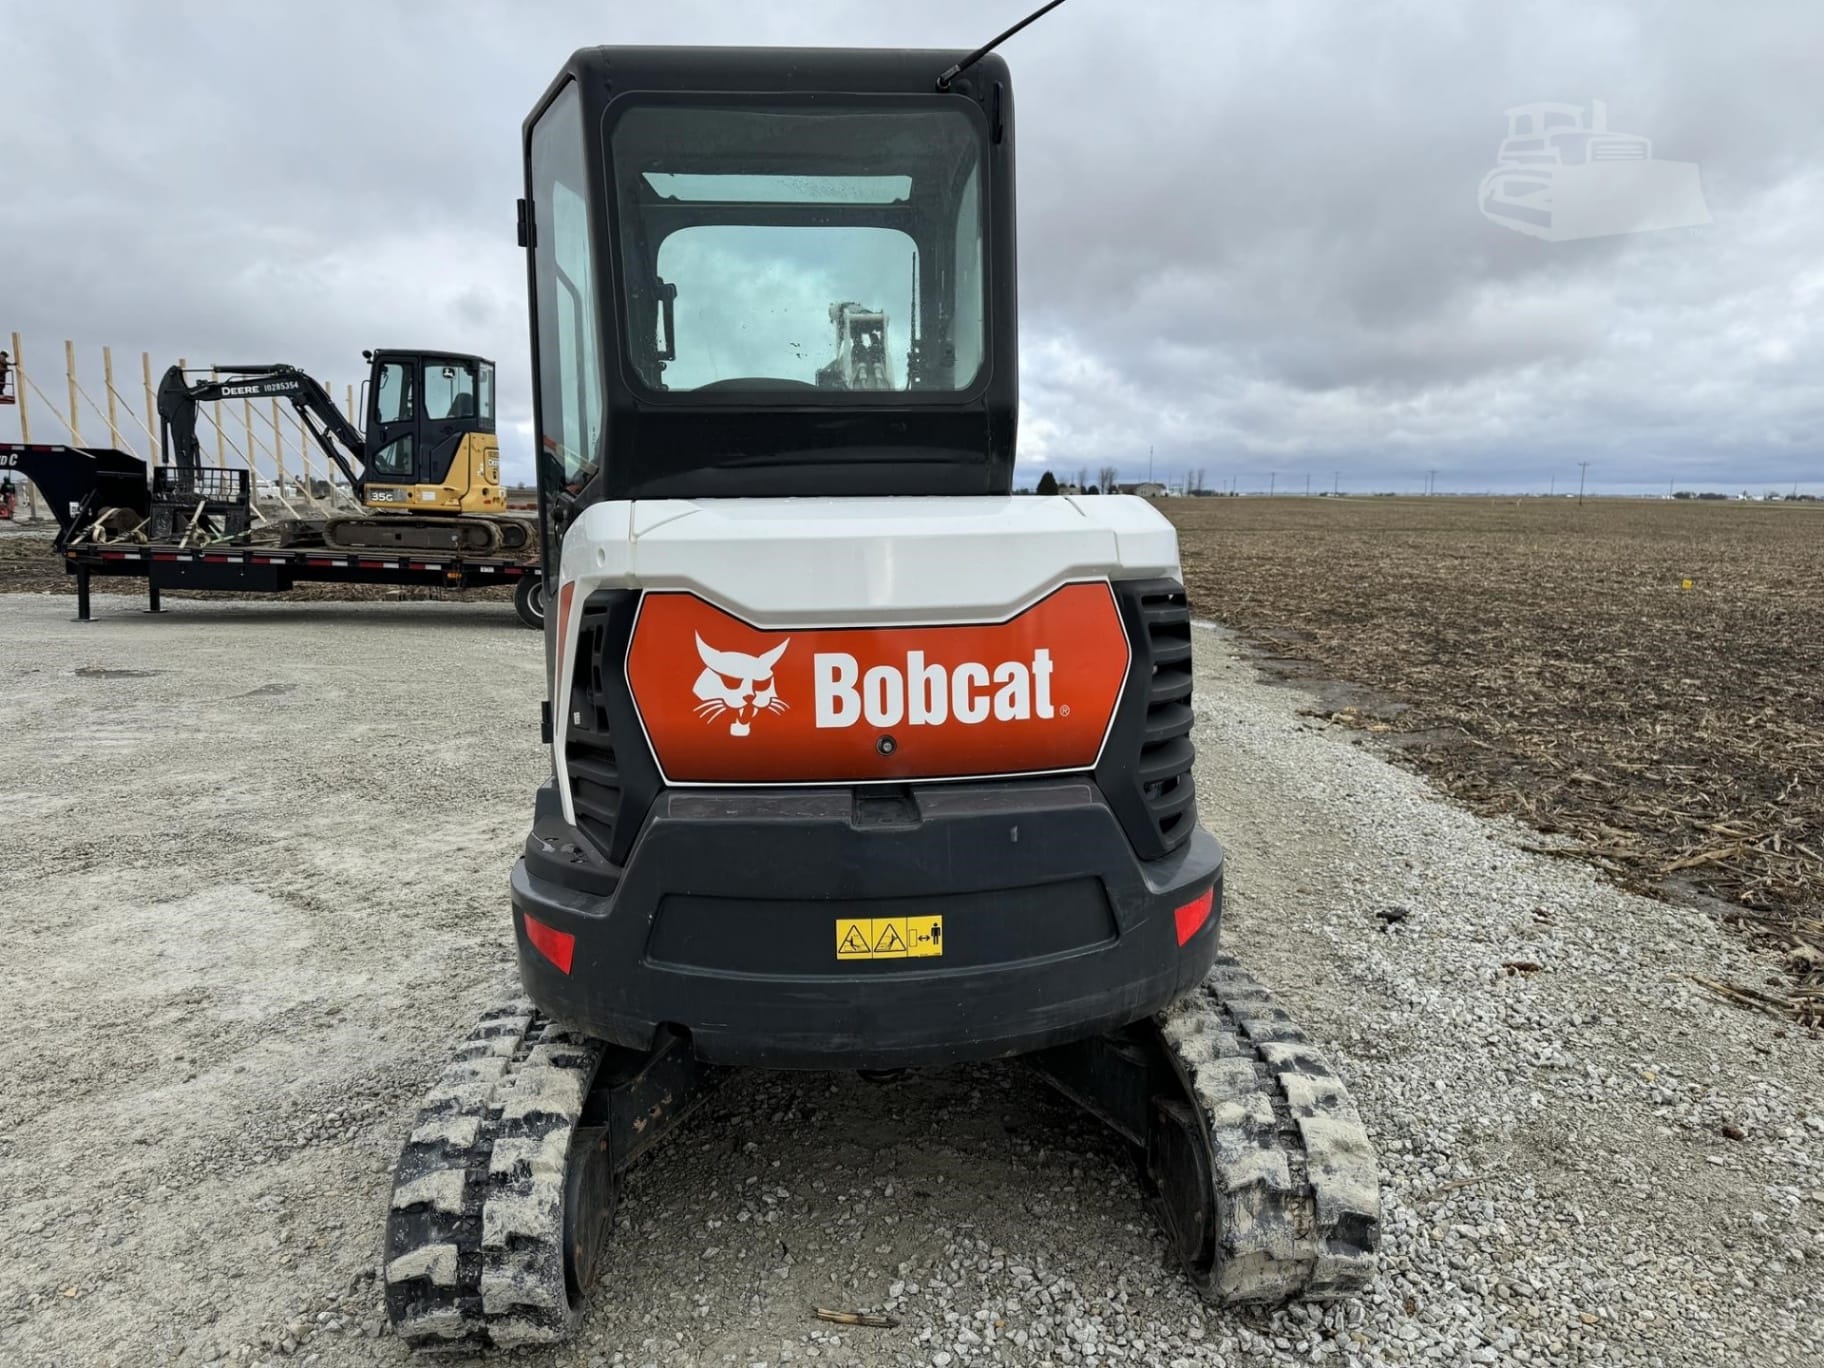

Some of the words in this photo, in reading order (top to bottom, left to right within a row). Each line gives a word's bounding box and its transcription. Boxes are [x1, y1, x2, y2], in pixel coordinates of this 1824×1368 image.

[221, 385, 260, 396] DEERE
[371, 492, 394, 502] 35G
[813, 648, 1055, 729] Bobcat
